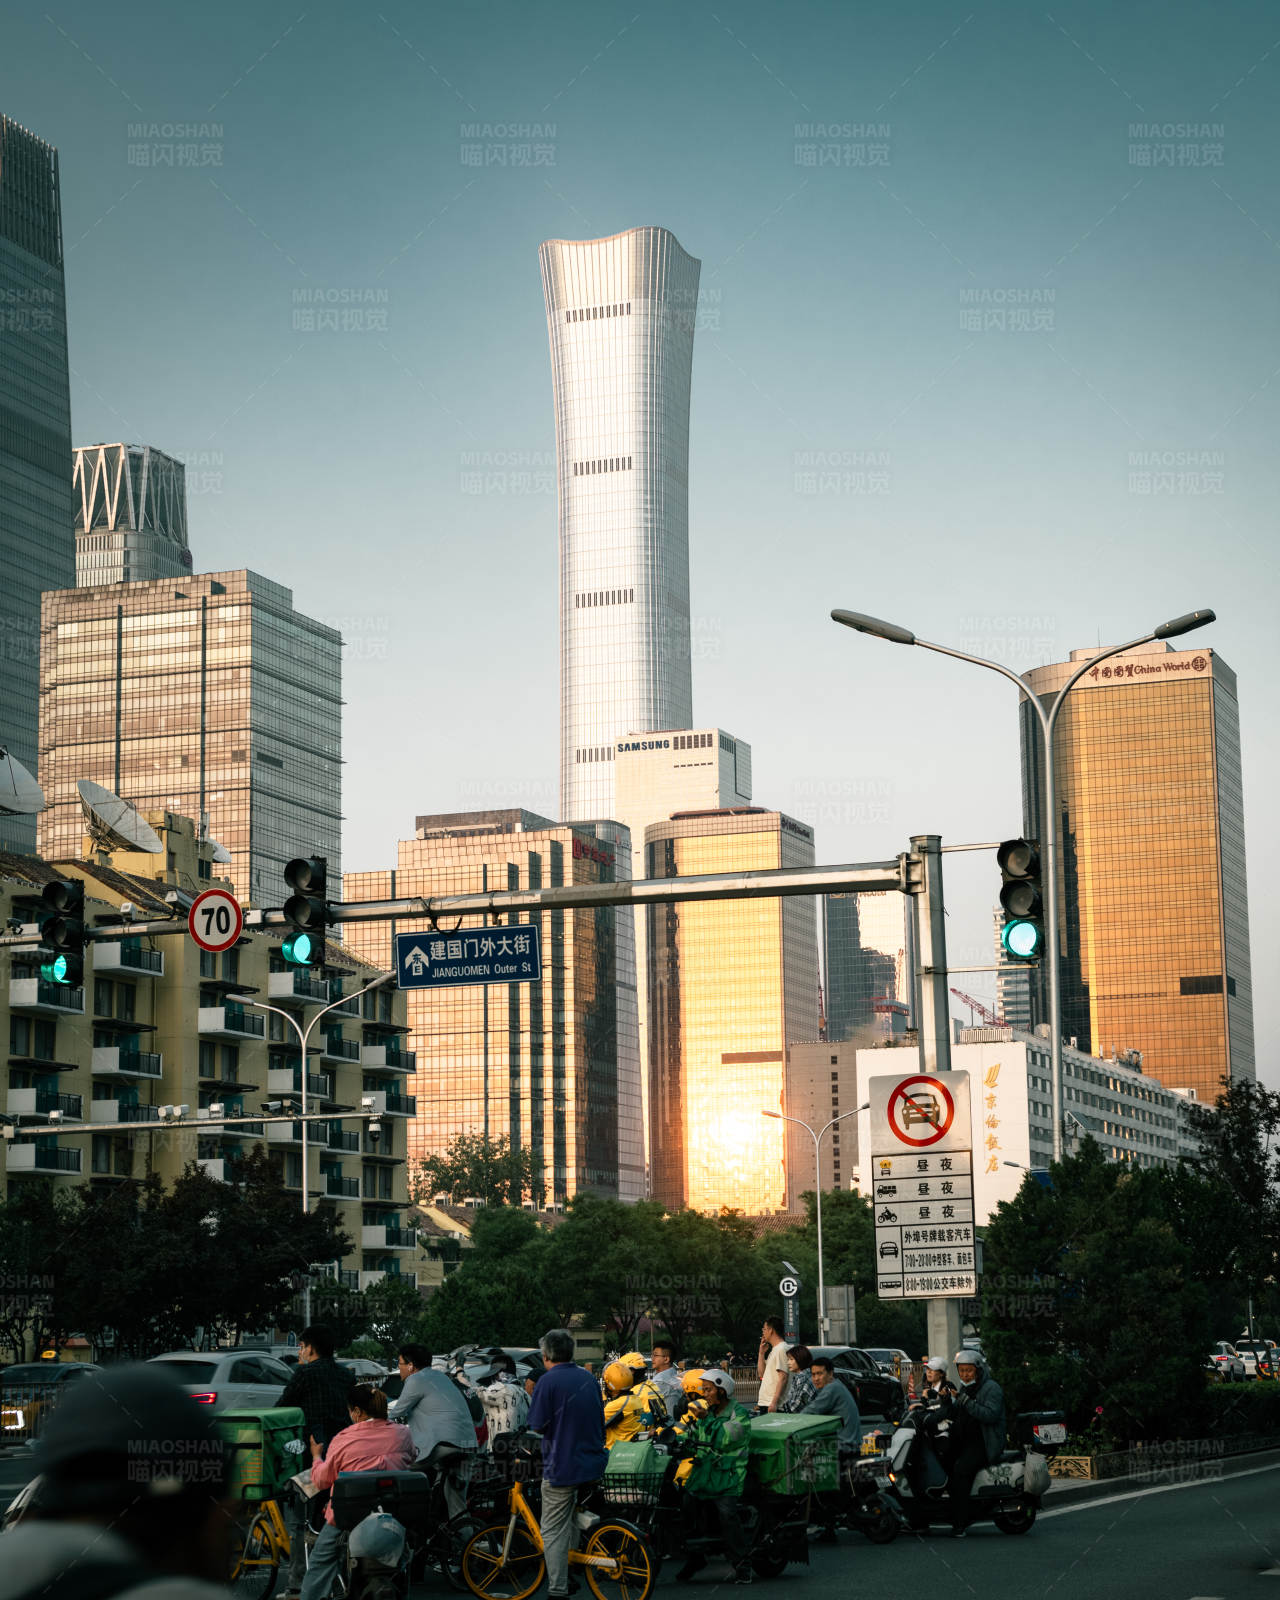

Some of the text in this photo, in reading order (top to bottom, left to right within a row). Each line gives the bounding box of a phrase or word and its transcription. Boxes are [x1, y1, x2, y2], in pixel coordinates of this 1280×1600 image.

[1134, 664, 1161, 675] China
[1163, 661, 1191, 672] World
[617, 740, 670, 752] SAMSUNG
[201, 906, 230, 935] 70
[430, 935, 530, 960] 建国门外大街
[432, 961, 532, 978] JIANGUOMEN Outer St
[904, 1228, 971, 1244] 外埠号牌载客汽车
